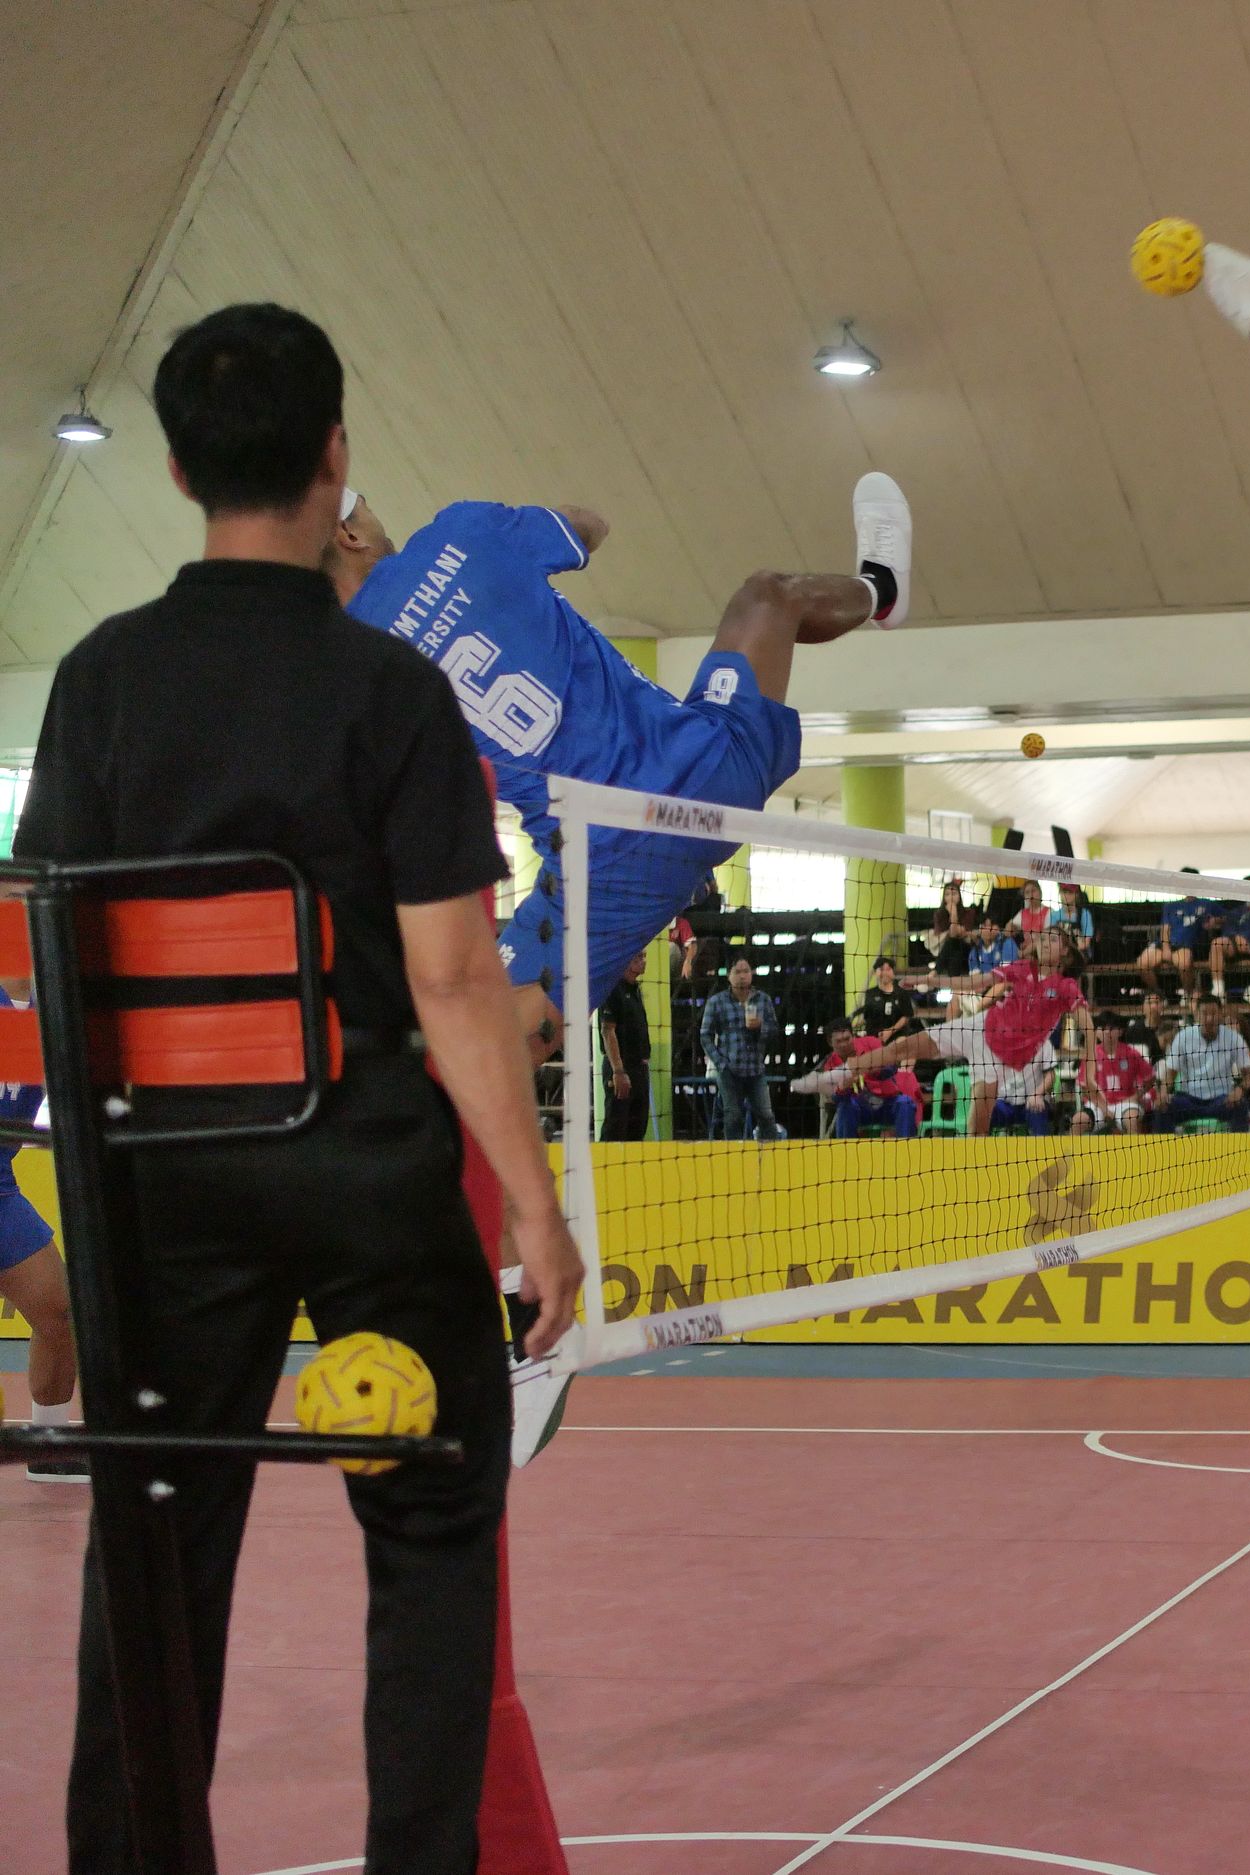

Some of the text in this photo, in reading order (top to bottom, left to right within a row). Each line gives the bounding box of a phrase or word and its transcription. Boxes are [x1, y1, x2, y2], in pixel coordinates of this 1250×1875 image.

[438, 631, 562, 757] 6
[656, 802, 724, 833] MARATHON
[653, 1314, 723, 1350] MARATHON
